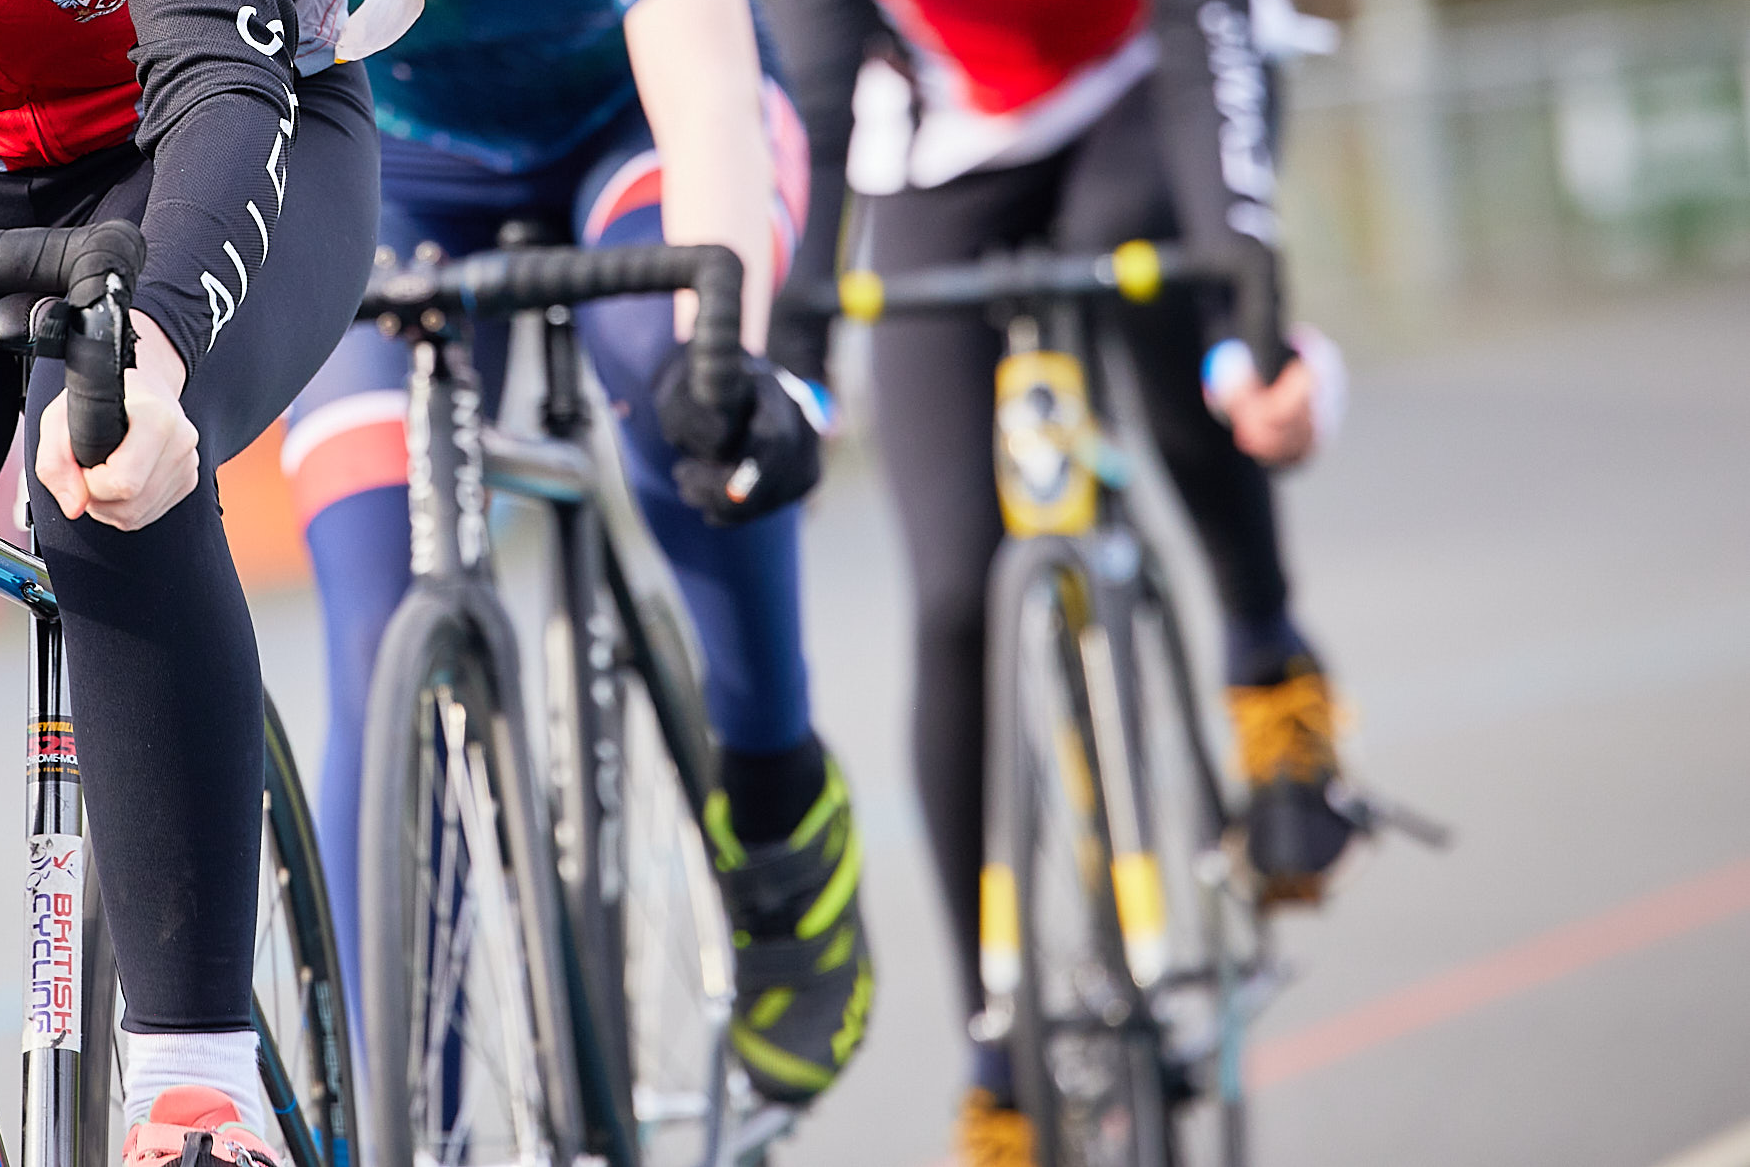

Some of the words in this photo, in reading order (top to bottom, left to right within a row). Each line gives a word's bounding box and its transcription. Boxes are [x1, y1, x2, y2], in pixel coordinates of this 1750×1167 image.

[29, 736, 76, 755] 525
[32, 893, 52, 1034] CYCLING
[53, 893, 73, 1034] BRITISH
